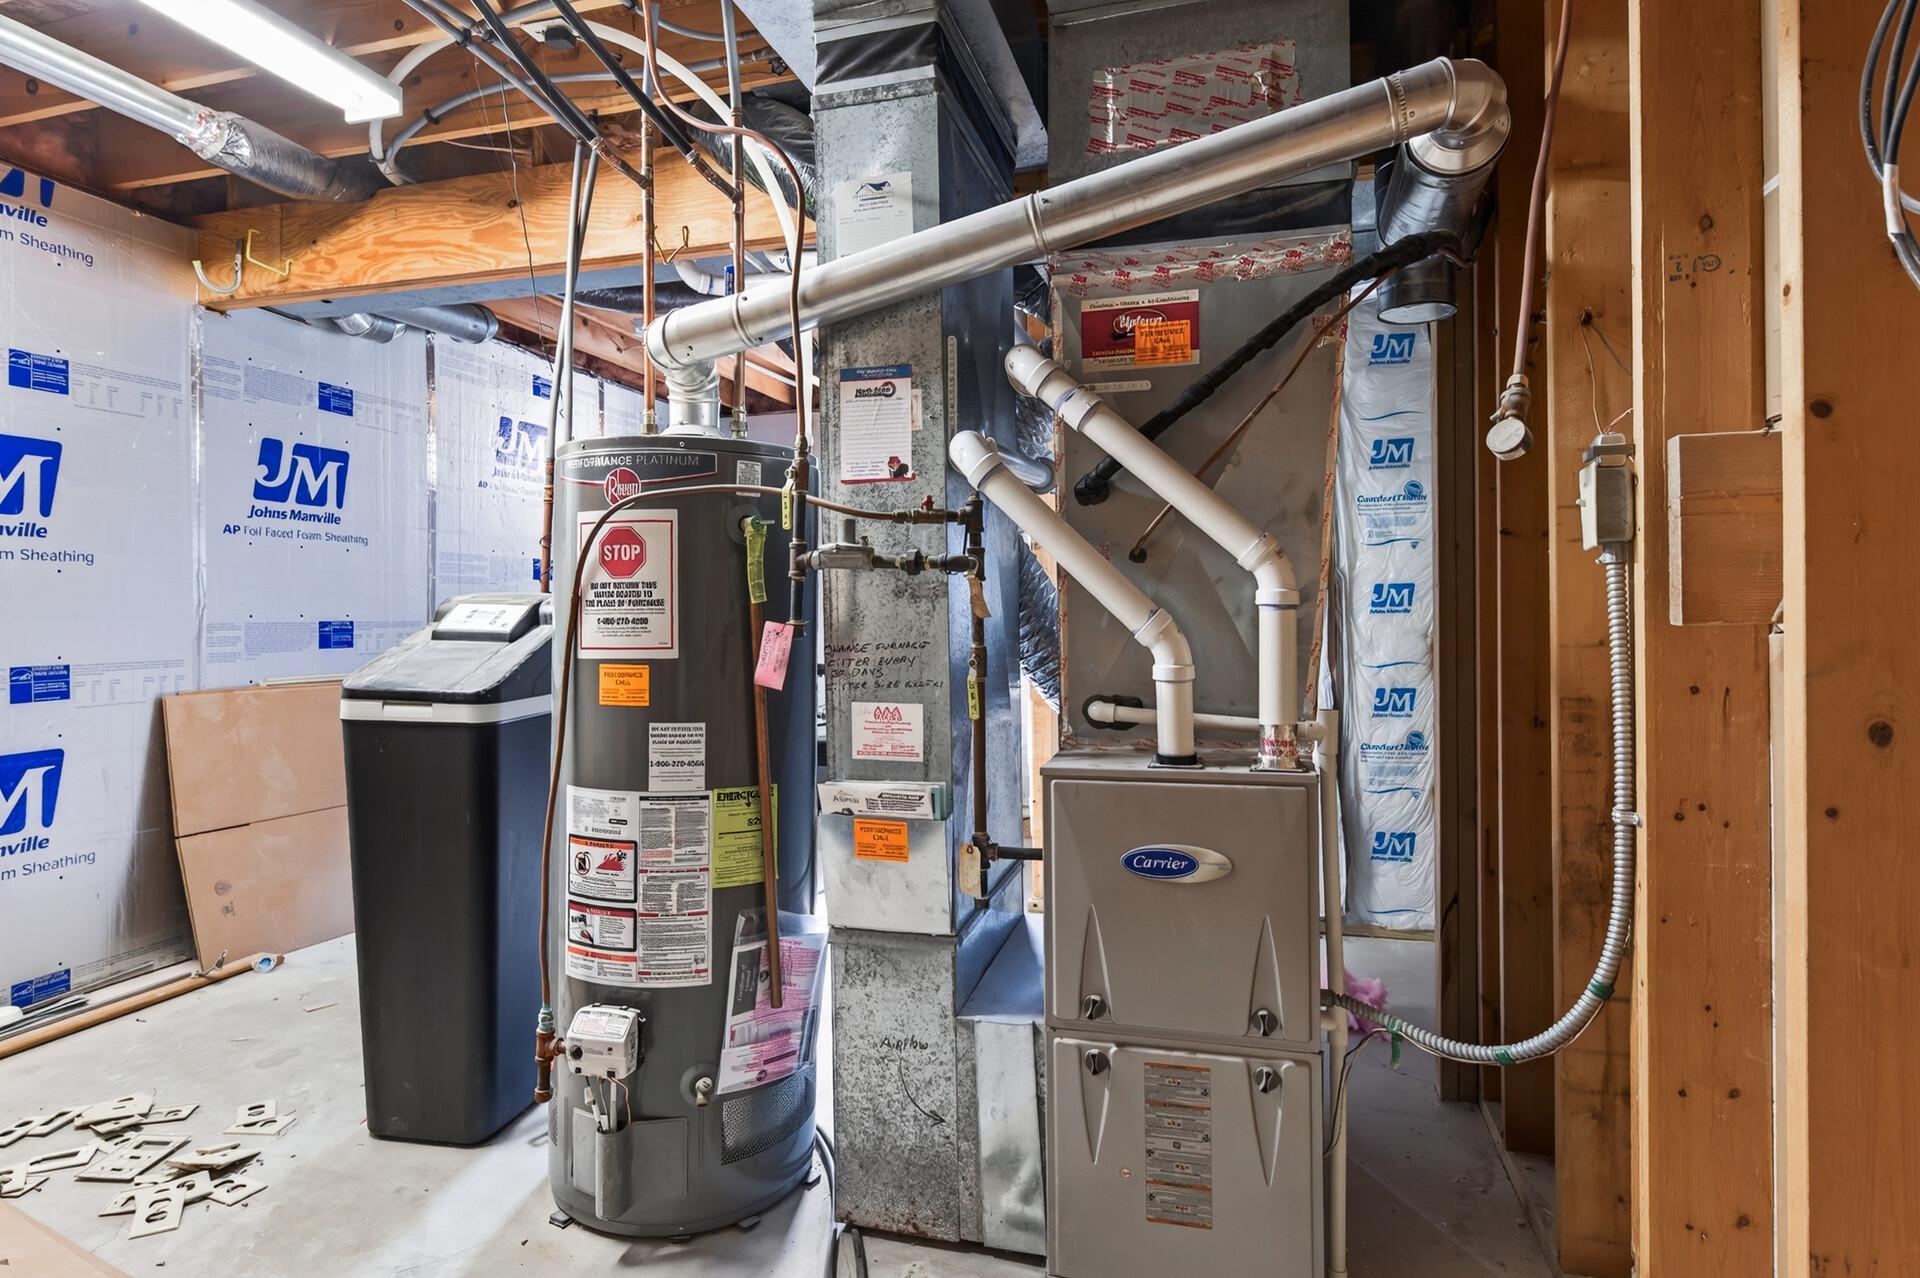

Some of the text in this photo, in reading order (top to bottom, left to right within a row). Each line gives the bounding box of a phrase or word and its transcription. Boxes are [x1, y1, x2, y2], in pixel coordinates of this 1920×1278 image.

[20, 232, 94, 268] Sheathing
[1371, 333, 1416, 359] JM
[636, 454, 699, 467] PLATINUM
[1370, 438, 1415, 465] JM
[253, 437, 350, 510] JM
[247, 505, 342, 525] Johns Manville
[223, 524, 241, 534] AP
[244, 525, 262, 537] Foil
[325, 532, 369, 547] Sheathing
[20, 548, 95, 566] Sheathing
[603, 544, 641, 561] STOP
[1371, 582, 1416, 608] JM
[1373, 687, 1416, 712] JM
[1372, 831, 1416, 857] JM
[22, 851, 96, 877] Sheathing
[1133, 855, 1188, 870] Carrier
